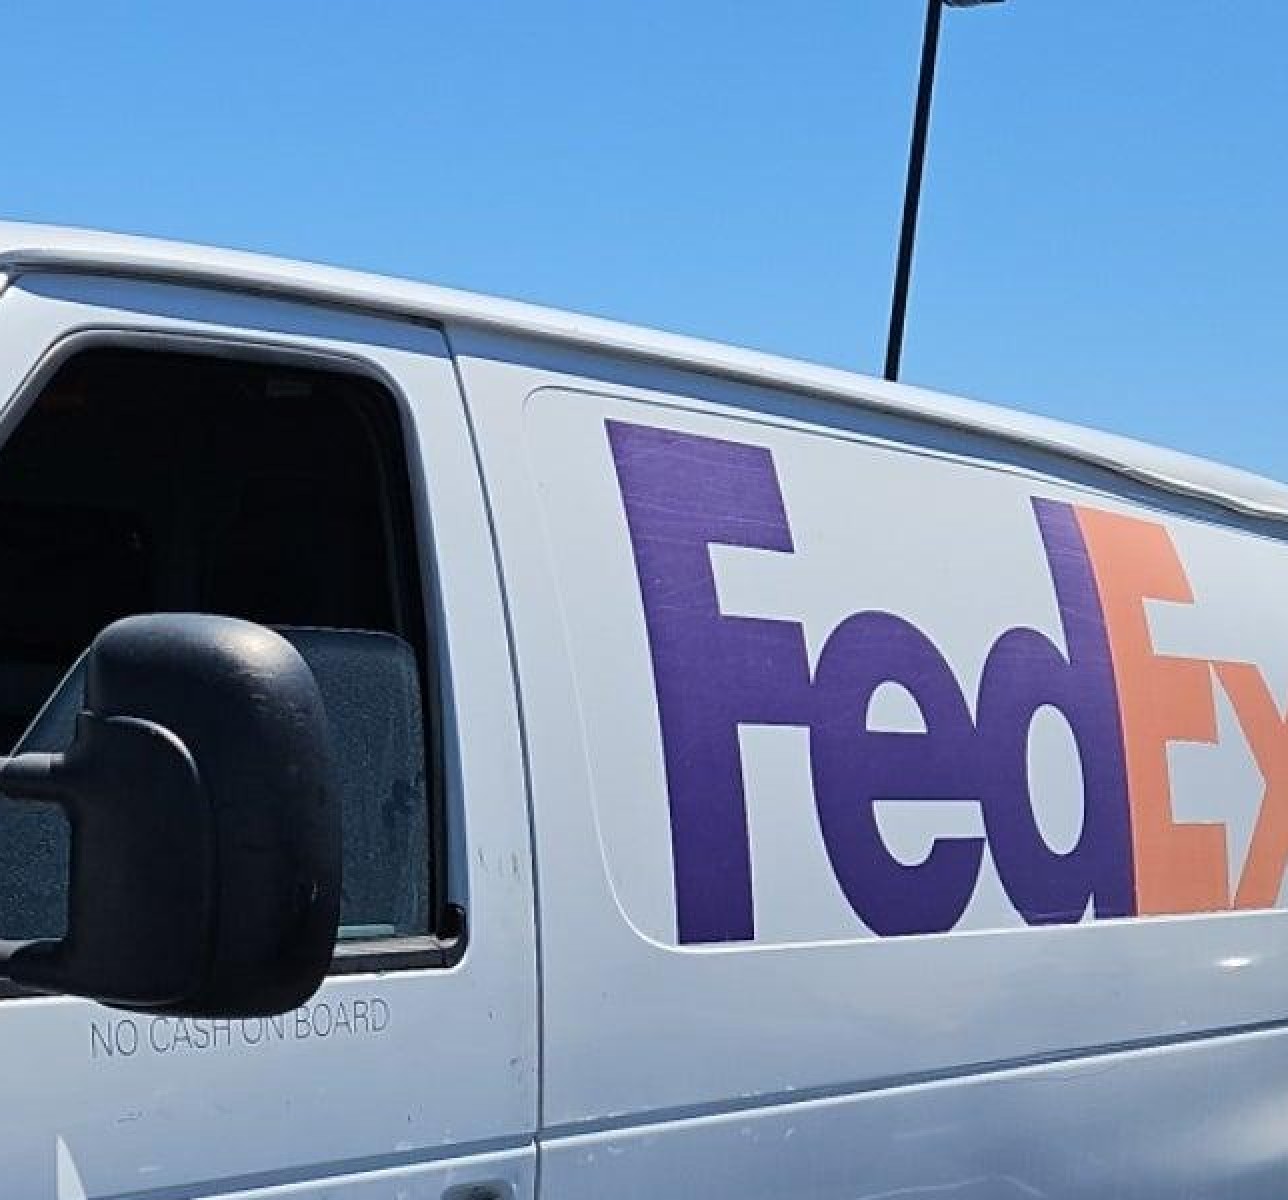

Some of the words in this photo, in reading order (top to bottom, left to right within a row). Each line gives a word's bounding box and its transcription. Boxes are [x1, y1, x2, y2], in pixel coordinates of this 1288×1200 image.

[91, 1018, 139, 1057] NO
[150, 1017, 231, 1053] CASH
[241, 1015, 285, 1045] ON
[296, 998, 391, 1040] BOARD
